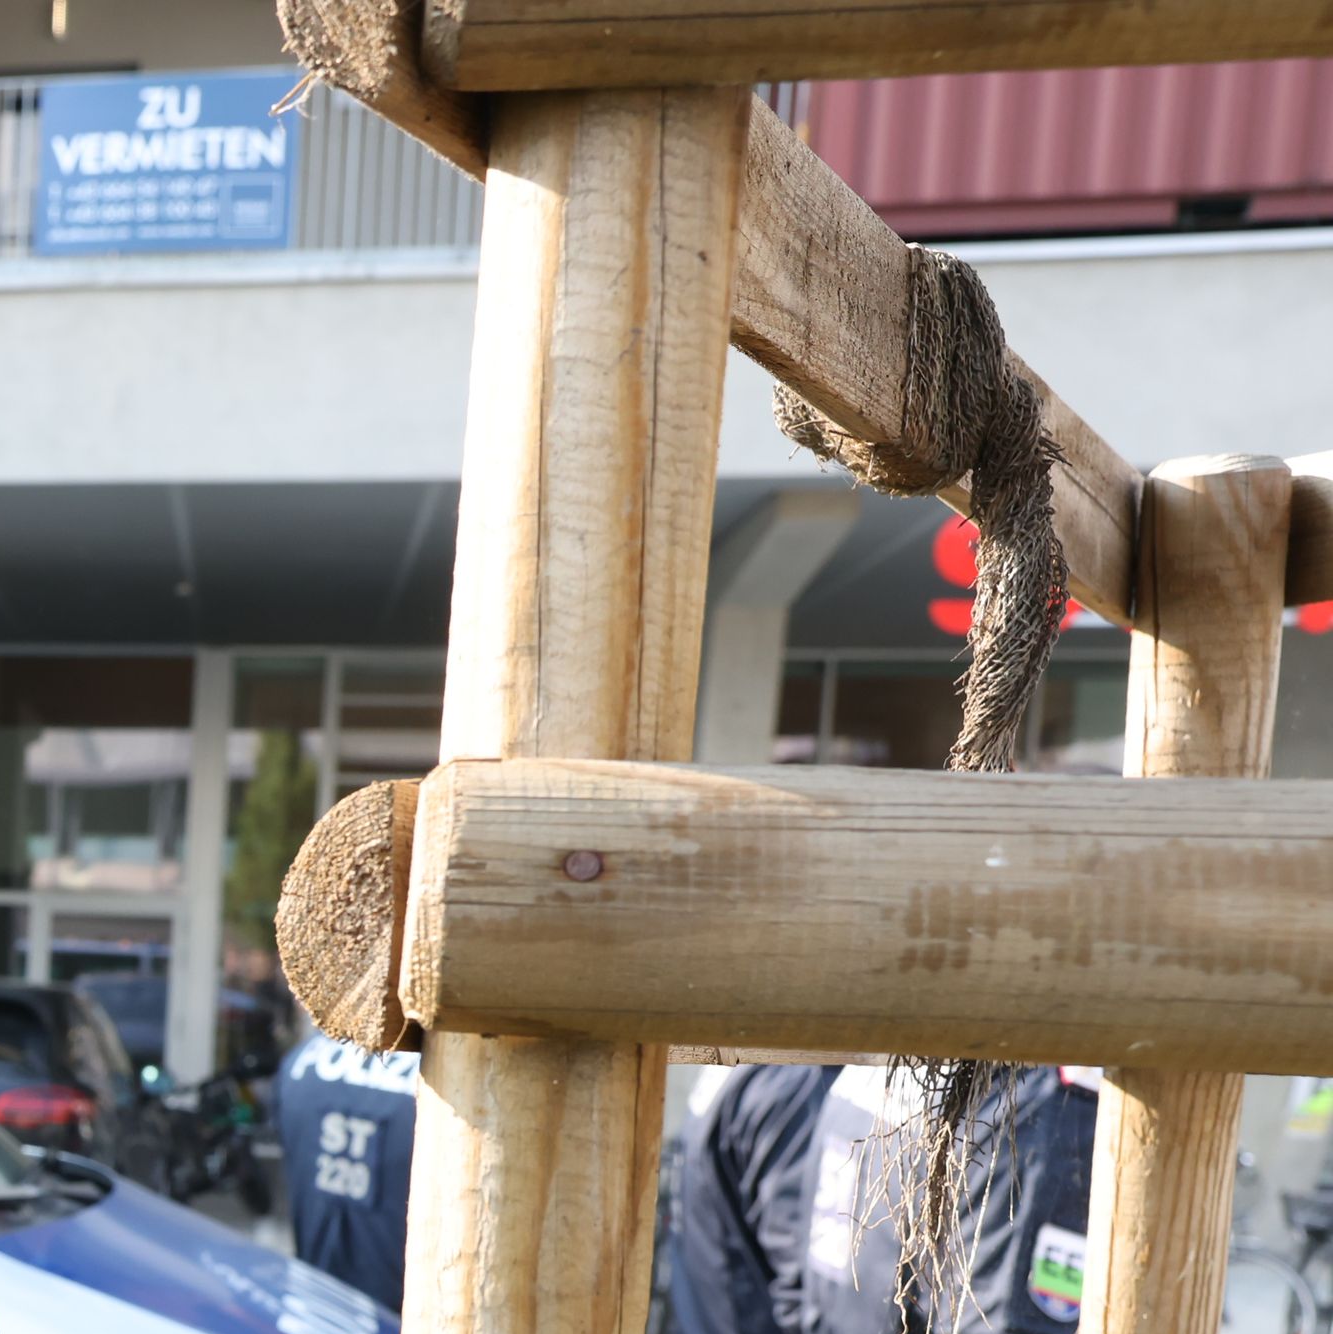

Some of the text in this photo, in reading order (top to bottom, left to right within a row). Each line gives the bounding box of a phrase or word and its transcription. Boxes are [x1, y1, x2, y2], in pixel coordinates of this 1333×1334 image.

[136, 84, 202, 131] ZU
[49, 125, 287, 176] VERMIETEN
[289, 1034, 422, 1097] POLIZ
[320, 1111, 377, 1159] ST
